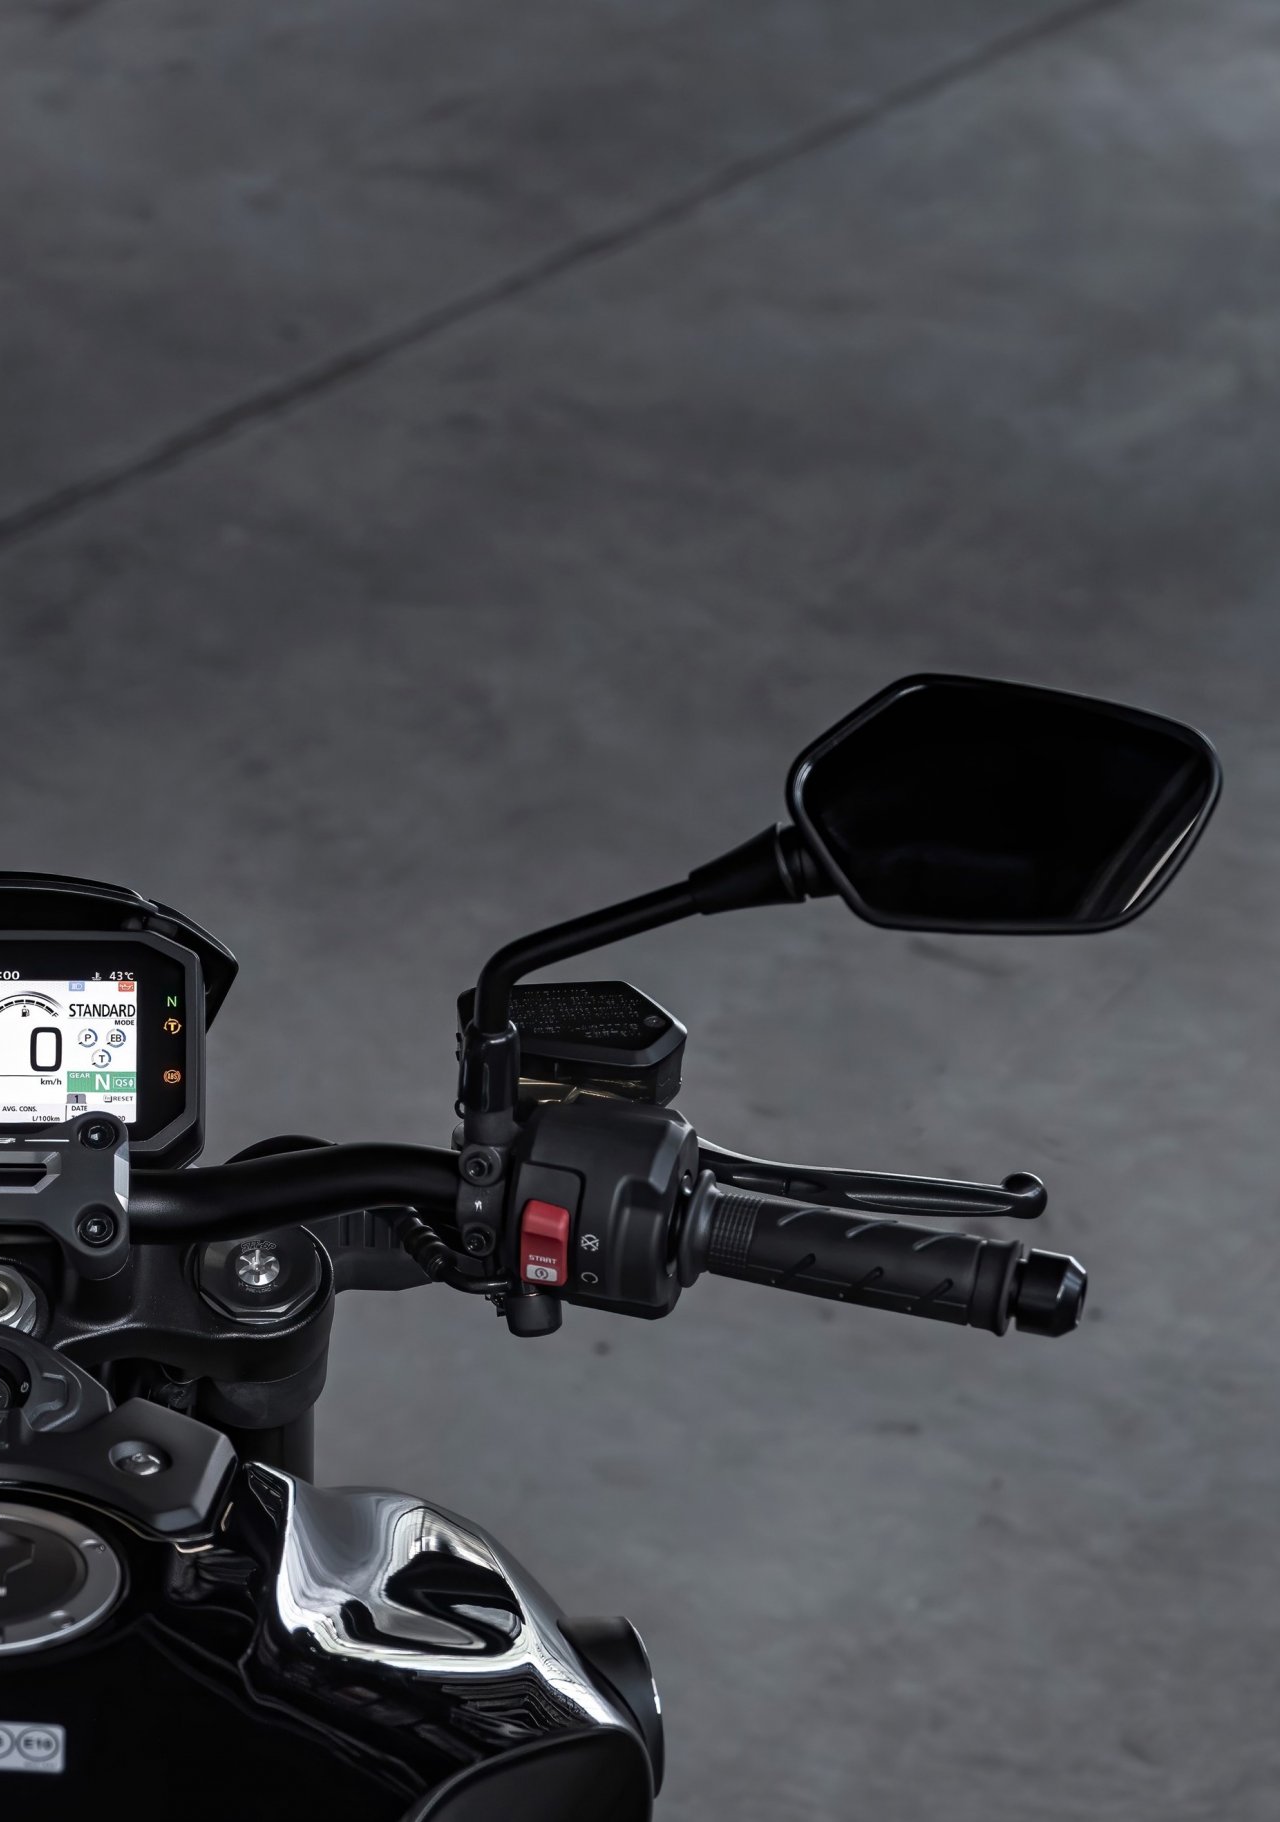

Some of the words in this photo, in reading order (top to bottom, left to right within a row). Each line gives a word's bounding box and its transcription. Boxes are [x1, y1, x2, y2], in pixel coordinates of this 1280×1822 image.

[166, 995, 177, 1007] N
[68, 1003, 136, 1018] STANDARD
[84, 1033, 92, 1043] P
[110, 1033, 122, 1043] EB
[29, 1026, 63, 1073] 0
[98, 1054, 106, 1064] T
[40, 1077, 63, 1086] km/h
[95, 1073, 111, 1091] N
[528, 1254, 557, 1265] START
[22, 1737, 54, 1751] E10
